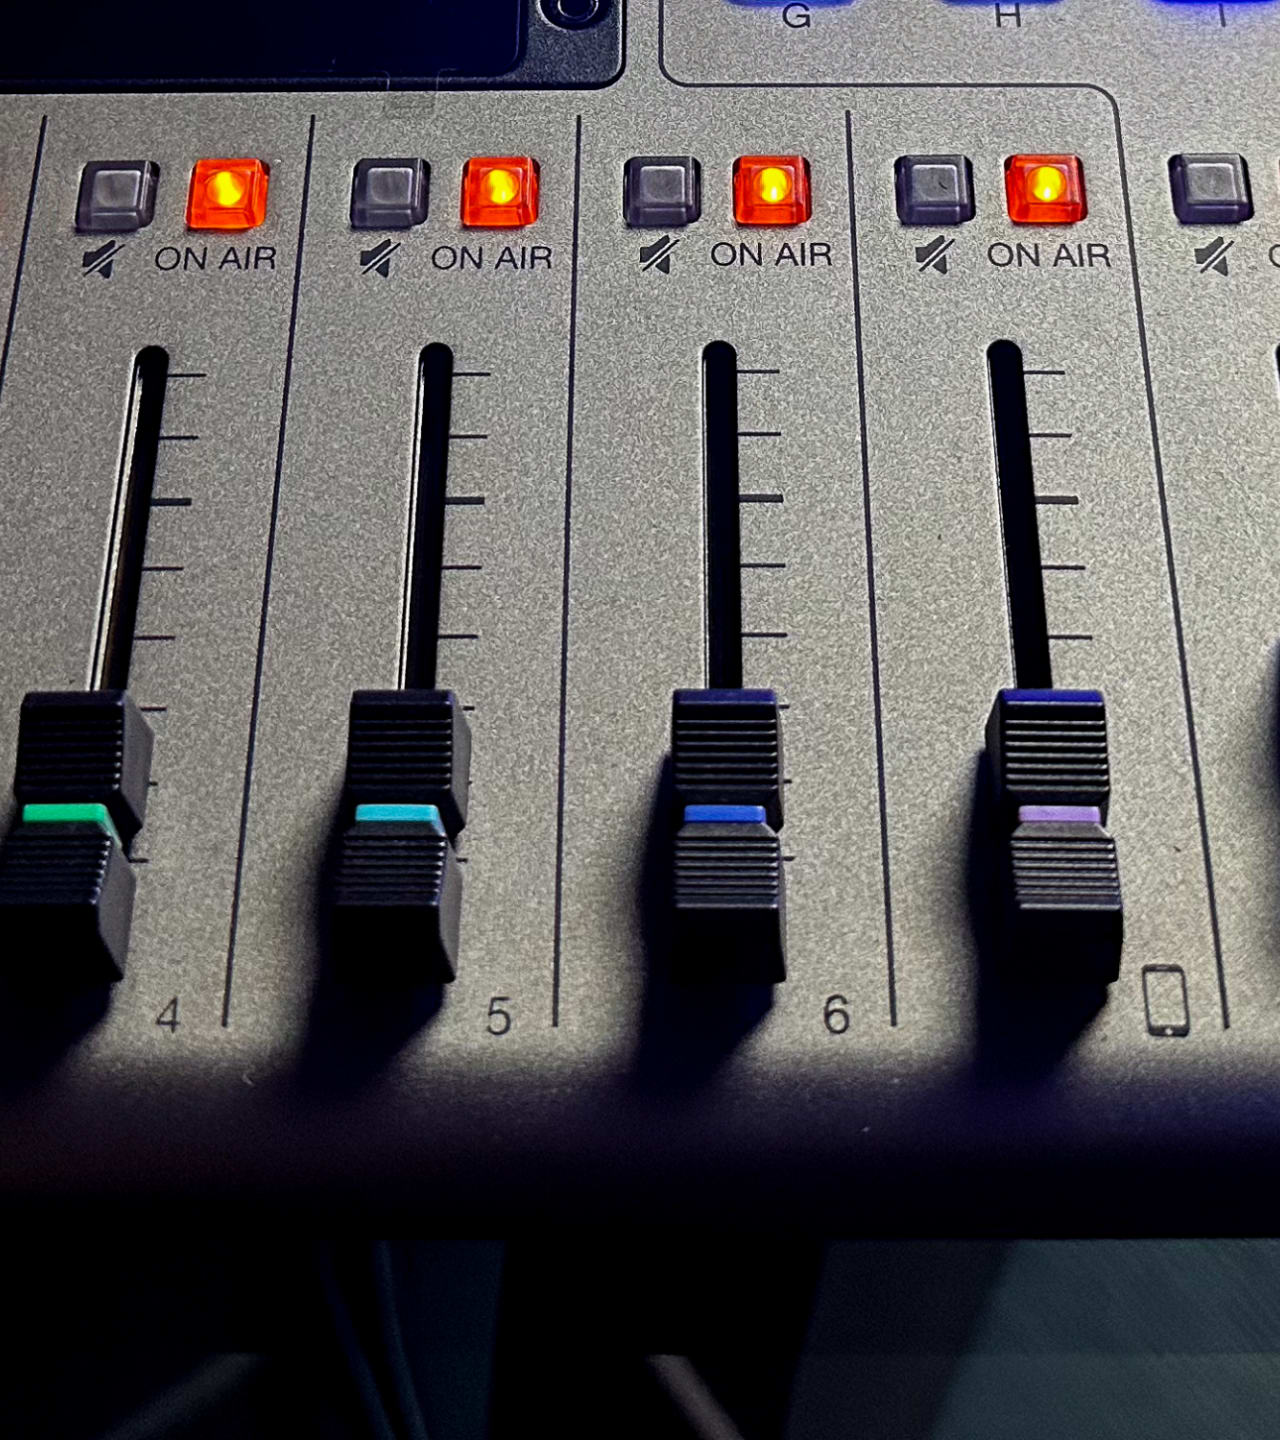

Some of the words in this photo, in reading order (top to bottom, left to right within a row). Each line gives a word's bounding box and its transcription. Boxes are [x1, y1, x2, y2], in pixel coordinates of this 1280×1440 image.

[781, 1, 812, 29] G
[994, 1, 1022, 28] H
[154, 246, 209, 271] ON
[218, 245, 278, 271] AIR
[431, 245, 484, 270] ON
[493, 244, 554, 270] AIR
[710, 241, 763, 267] ON
[774, 241, 834, 267] AIR
[986, 241, 1041, 268] ON
[1051, 241, 1112, 268] AIR
[155, 996, 182, 1034] 4
[486, 995, 512, 1036] 5
[822, 993, 851, 1035] 6
